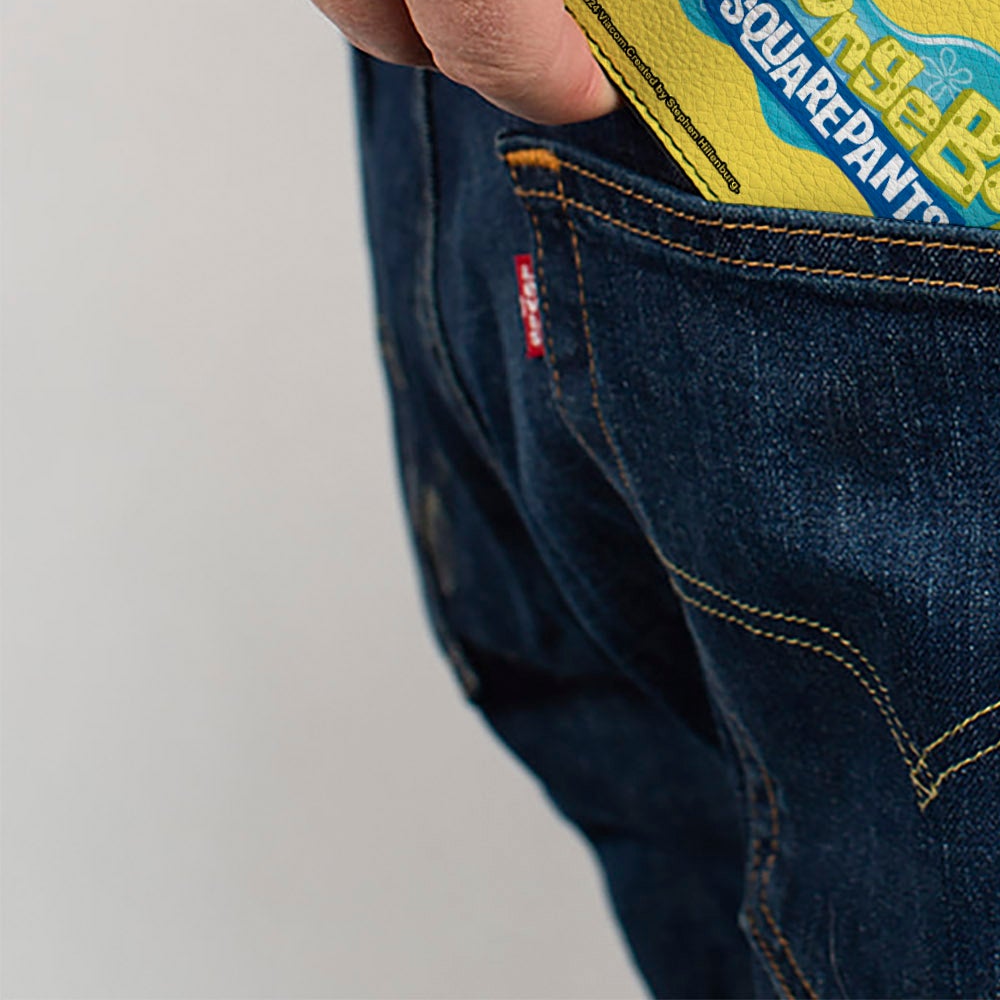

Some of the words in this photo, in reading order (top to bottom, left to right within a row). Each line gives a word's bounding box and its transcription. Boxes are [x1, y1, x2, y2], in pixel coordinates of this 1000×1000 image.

[653, 80, 669, 102] by
[664, 95, 701, 145] Stephen
[697, 135, 741, 195] Hillenburg.
